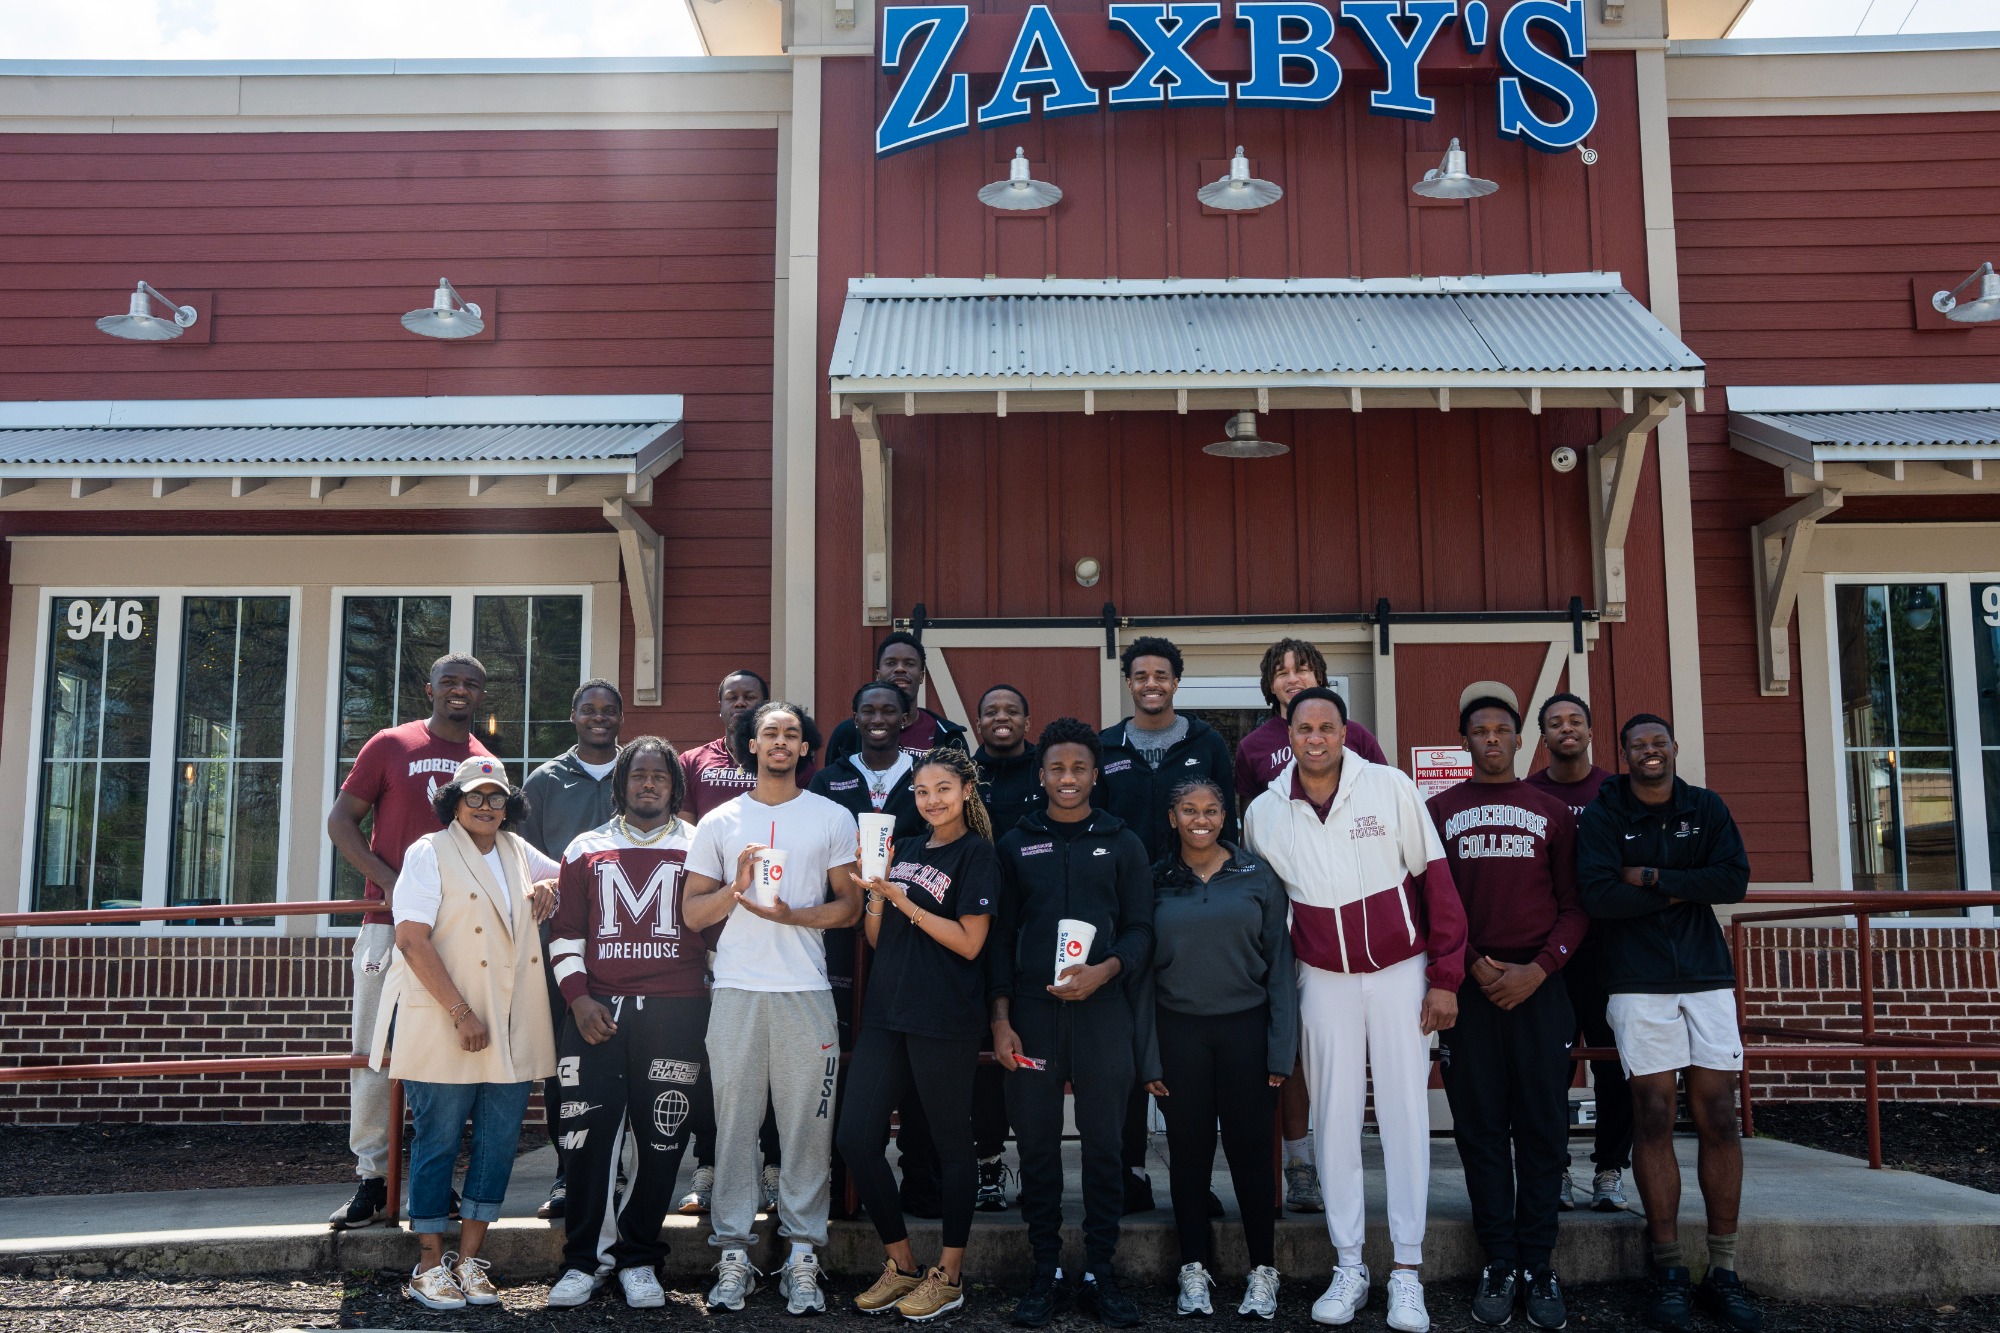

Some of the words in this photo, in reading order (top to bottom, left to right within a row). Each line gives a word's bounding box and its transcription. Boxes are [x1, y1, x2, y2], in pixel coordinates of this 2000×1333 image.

[876, 0, 1598, 154] ZAXBY'S
[67, 600, 143, 640] 946
[409, 758, 460, 776] MOREH
[1417, 769, 1443, 777] PRIVATE
[1445, 769, 1473, 777] PARKING
[1349, 825, 1386, 840] HOUSE
[1445, 804, 1548, 840] MOREHOUSE
[878, 827, 889, 858] ZAXBYS
[1458, 834, 1536, 859] COLLEGE
[762, 859, 770, 886] ZAXBYS
[594, 860, 685, 939] M
[598, 942, 680, 960] MOREHOUSE
[1058, 932, 1069, 963] ZAXBYS
[650, 1068, 697, 1081] CHARGED
[652, 1060, 689, 1072] SUPER
[816, 1056, 836, 1119] USA
